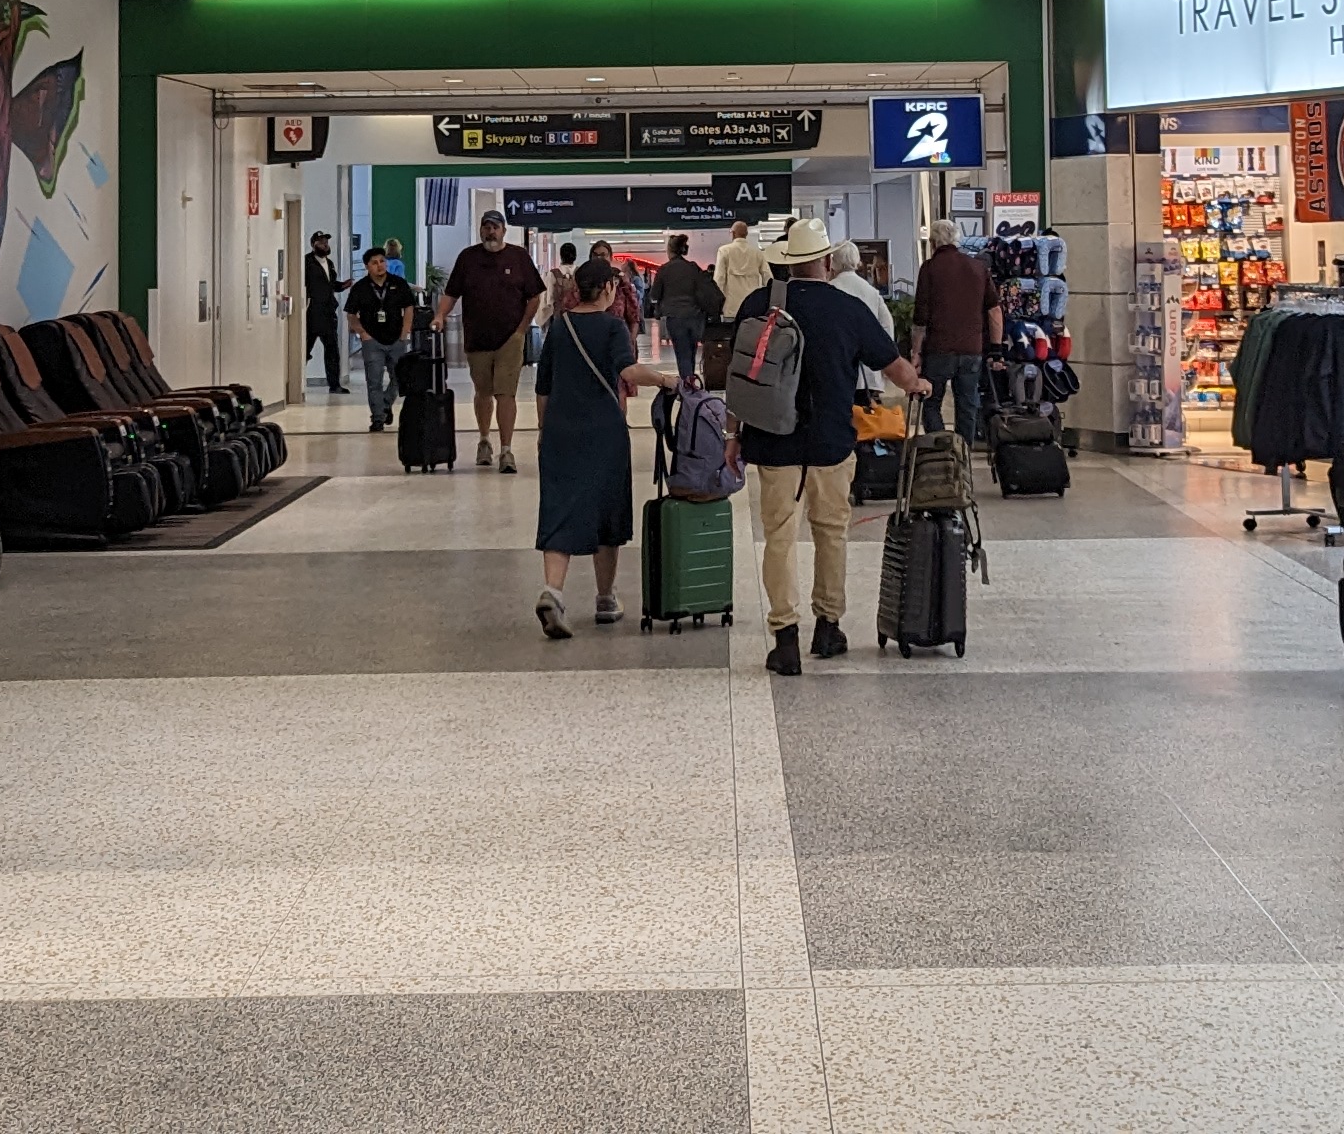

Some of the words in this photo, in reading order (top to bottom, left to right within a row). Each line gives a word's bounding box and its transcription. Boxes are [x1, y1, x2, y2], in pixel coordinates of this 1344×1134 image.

[905, 101, 948, 113] KPRC
[690, 125, 721, 135] Gates
[723, 124, 771, 134] A3a-A3h
[1159, 117, 1178, 131] WS
[485, 134, 527, 146] Skyway
[529, 134, 542, 143] to:
[548, 133, 556, 143] B
[561, 133, 569, 142] C
[574, 132, 581, 142] D
[588, 132, 594, 142] E
[902, 112, 949, 163] 2
[1194, 156, 1221, 165] KIND
[1294, 118, 1307, 201] HOUSTON
[1306, 101, 1327, 214] ASTROS
[736, 182, 768, 201] A1
[994, 194, 1007, 203] BUY
[1008, 194, 1012, 203] 2
[1013, 194, 1028, 203] SAVE
[1168, 309, 1177, 357] evian
